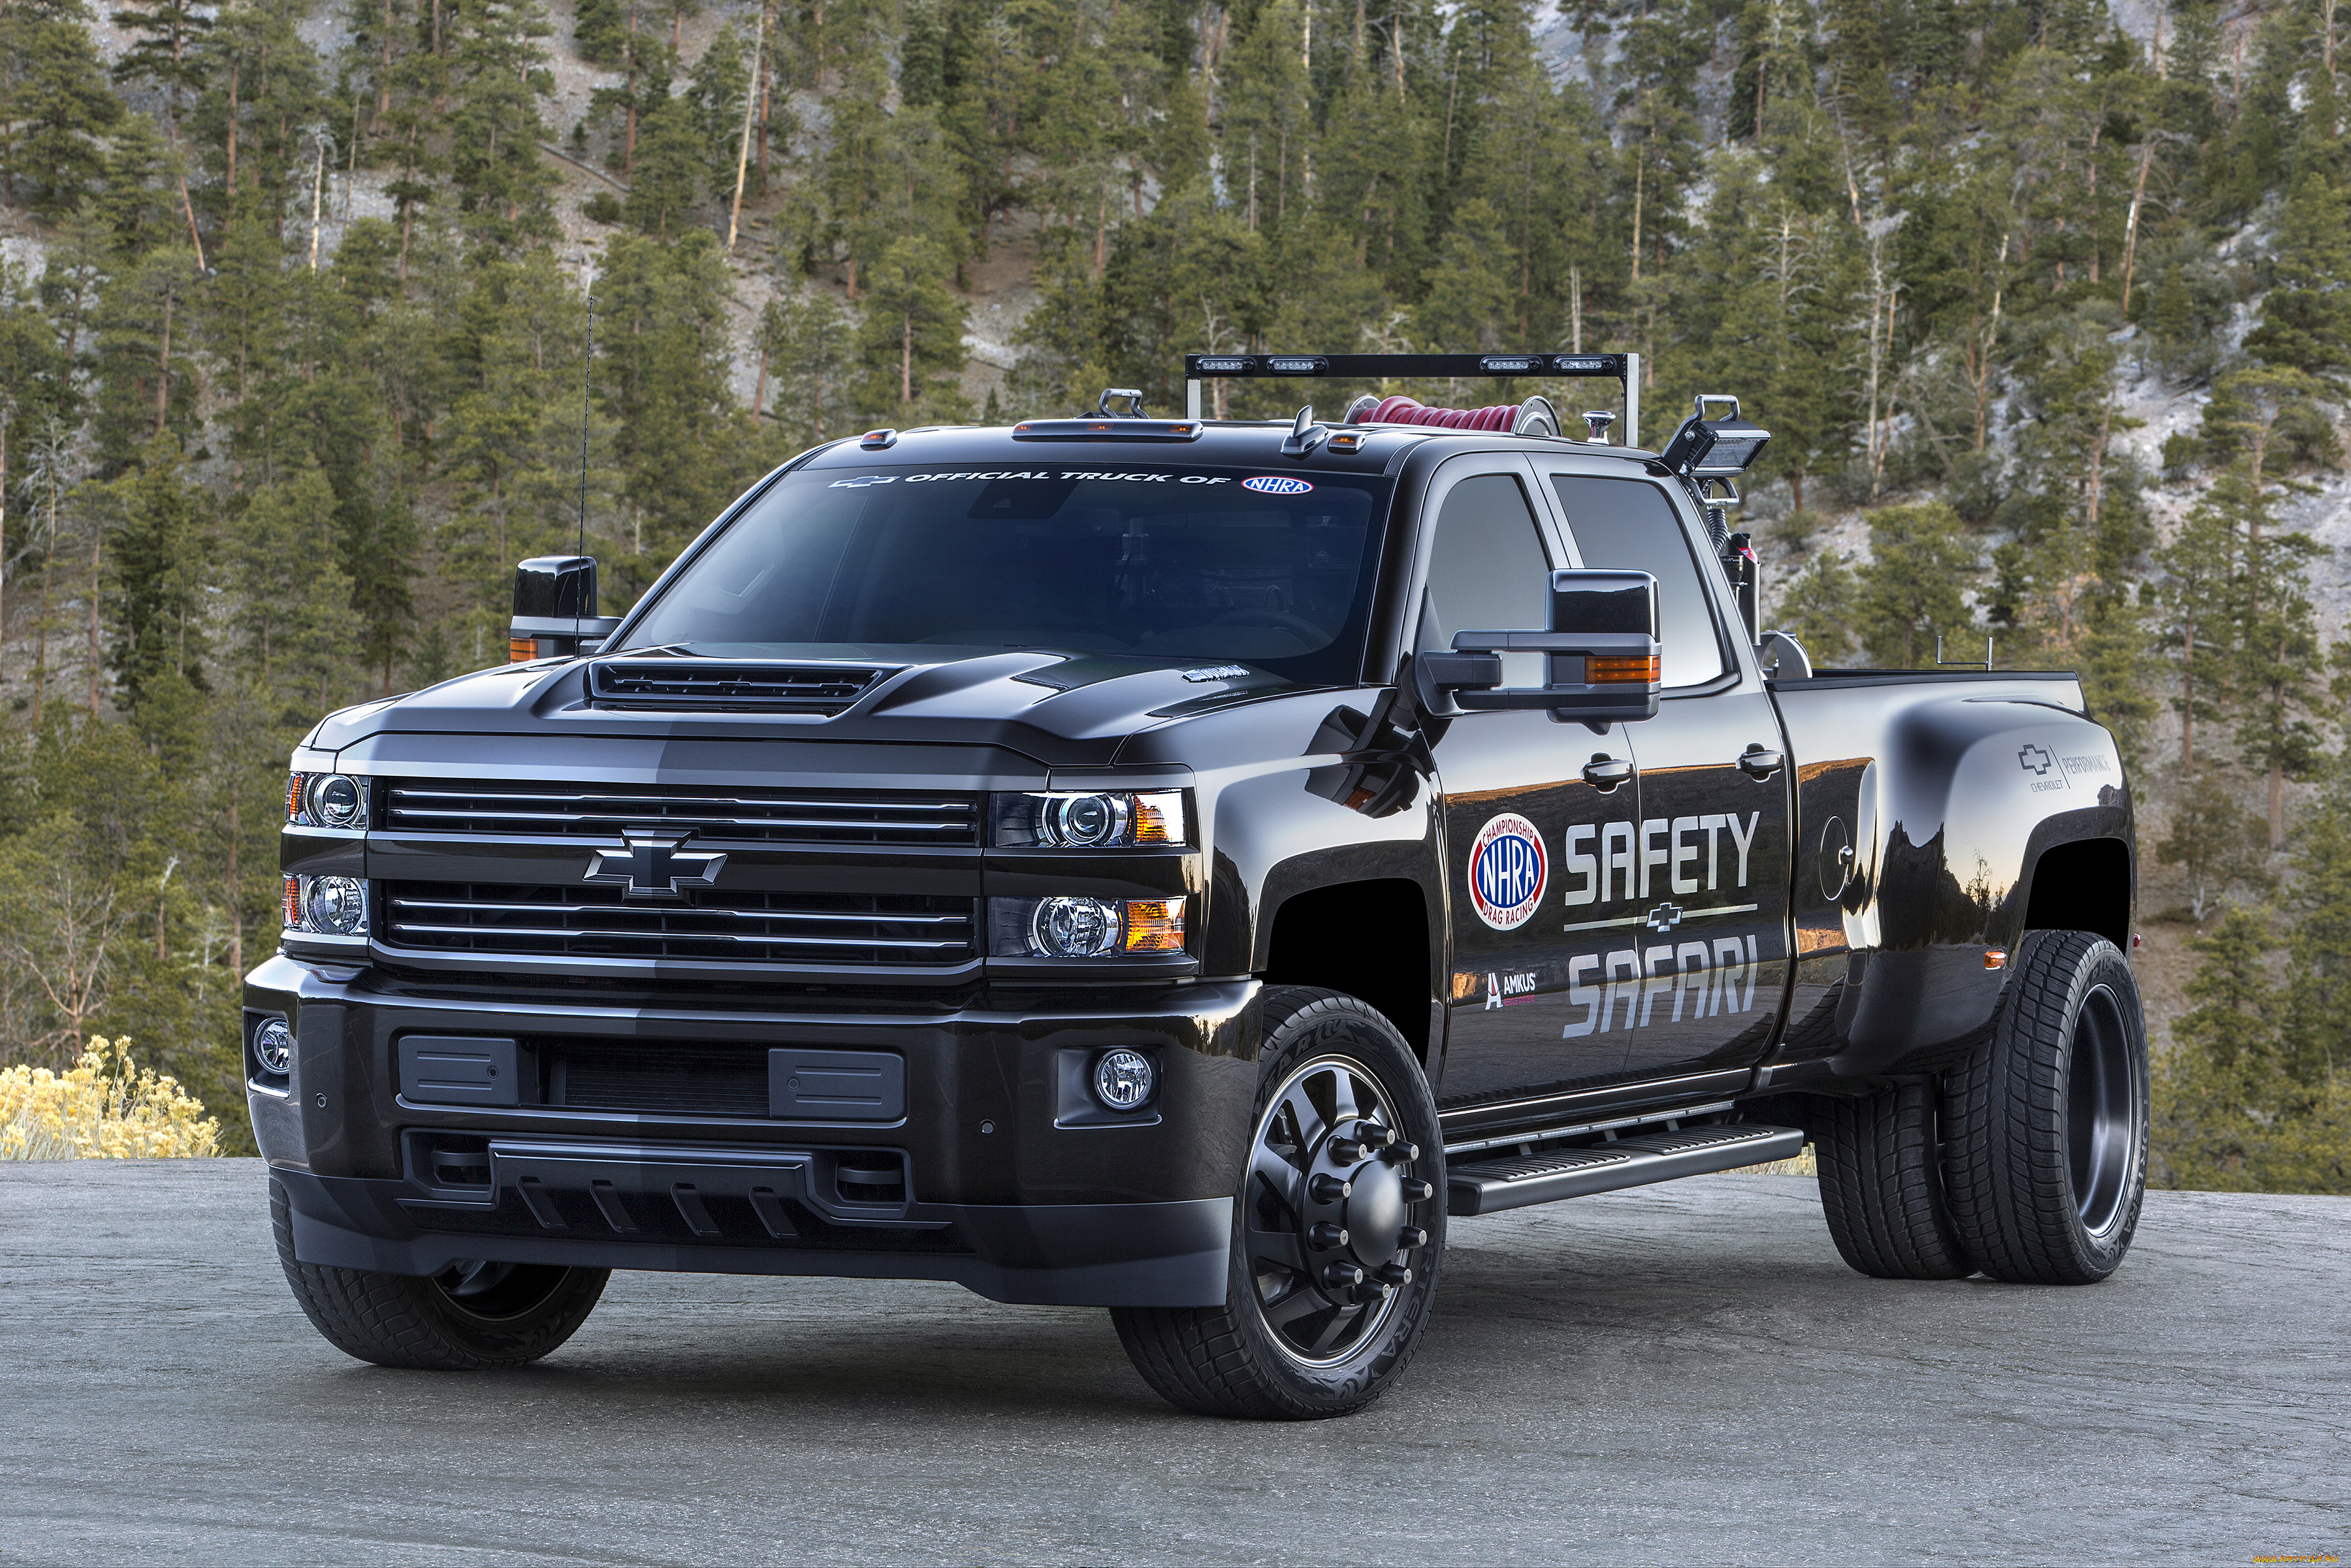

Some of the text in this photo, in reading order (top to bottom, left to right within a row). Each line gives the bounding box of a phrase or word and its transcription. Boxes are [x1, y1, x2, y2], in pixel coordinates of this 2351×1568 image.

[904, 472, 1305, 493] OFFICIAL TRUCK OF NHRA
[2061, 754, 2111, 775] PERFORMANCE
[2030, 780, 2064, 793] CHEVROLET
[1482, 818, 1533, 848] CHAMPIONSHIP
[1483, 838, 1535, 905] NHRA
[1565, 811, 1760, 906] SAFETY
[1483, 897, 1533, 925] DRAG RACING
[1563, 935, 1757, 1038] SAFARI
[2123, 1100, 2149, 1233] FORTERA
